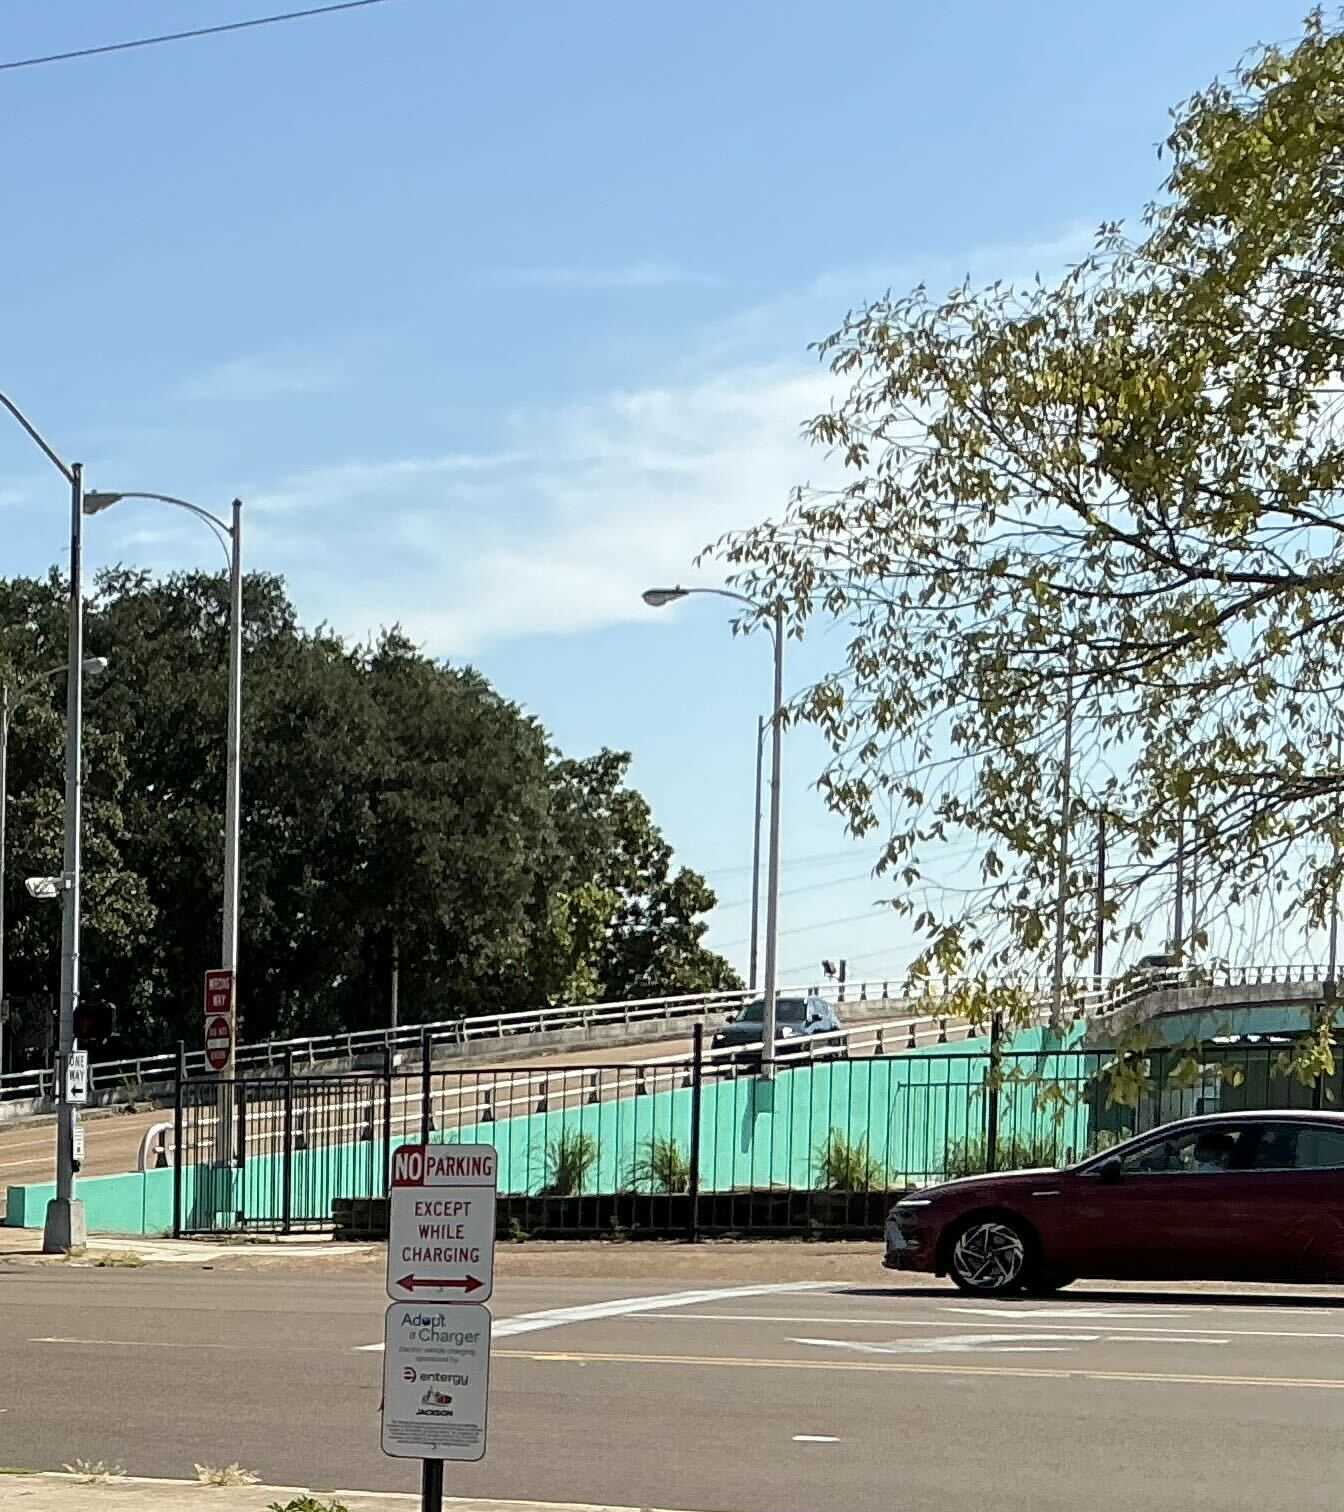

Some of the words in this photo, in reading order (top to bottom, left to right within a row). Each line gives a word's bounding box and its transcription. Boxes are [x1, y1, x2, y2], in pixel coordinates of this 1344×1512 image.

[68, 1054, 84, 1067] ONE
[69, 1069, 85, 1081] WAY
[395, 1151, 423, 1181] NO
[426, 1156, 493, 1177] PARKING
[414, 1200, 472, 1217] EXCEPT
[417, 1223, 465, 1240] WHILE
[401, 1246, 481, 1264] CHARGING
[401, 1312, 447, 1329] Adopt
[417, 1327, 481, 1346] Charger
[419, 1369, 470, 1386] entergy
